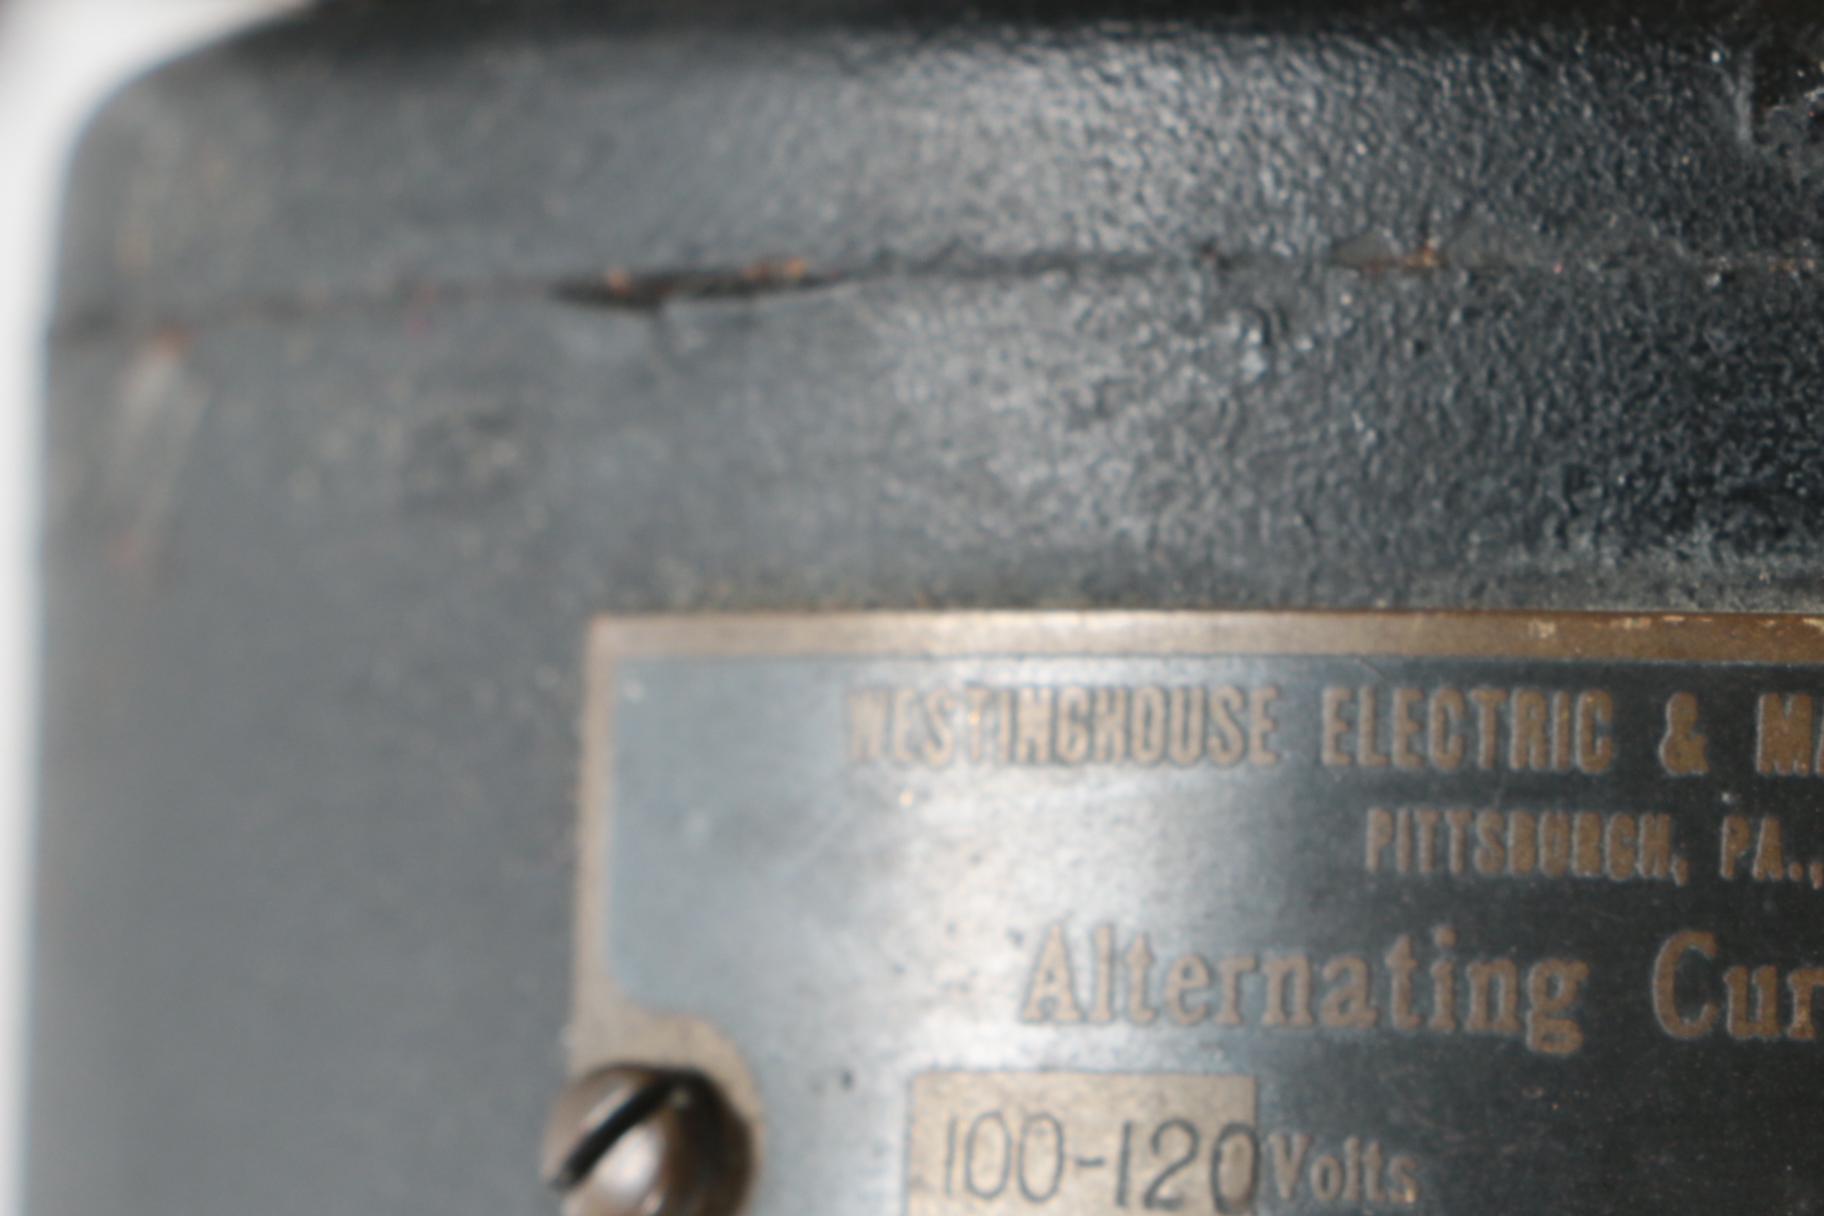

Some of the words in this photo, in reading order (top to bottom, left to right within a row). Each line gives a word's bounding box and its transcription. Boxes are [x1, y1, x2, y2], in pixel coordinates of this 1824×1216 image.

[845, 684, 1281, 768] WESTINGHOUSE
[1320, 684, 1614, 775] ELECTRIC
[1657, 690, 1709, 778] &
[1019, 920, 1590, 1055] Alternating
[1265, 1132, 1421, 1205] Volts
